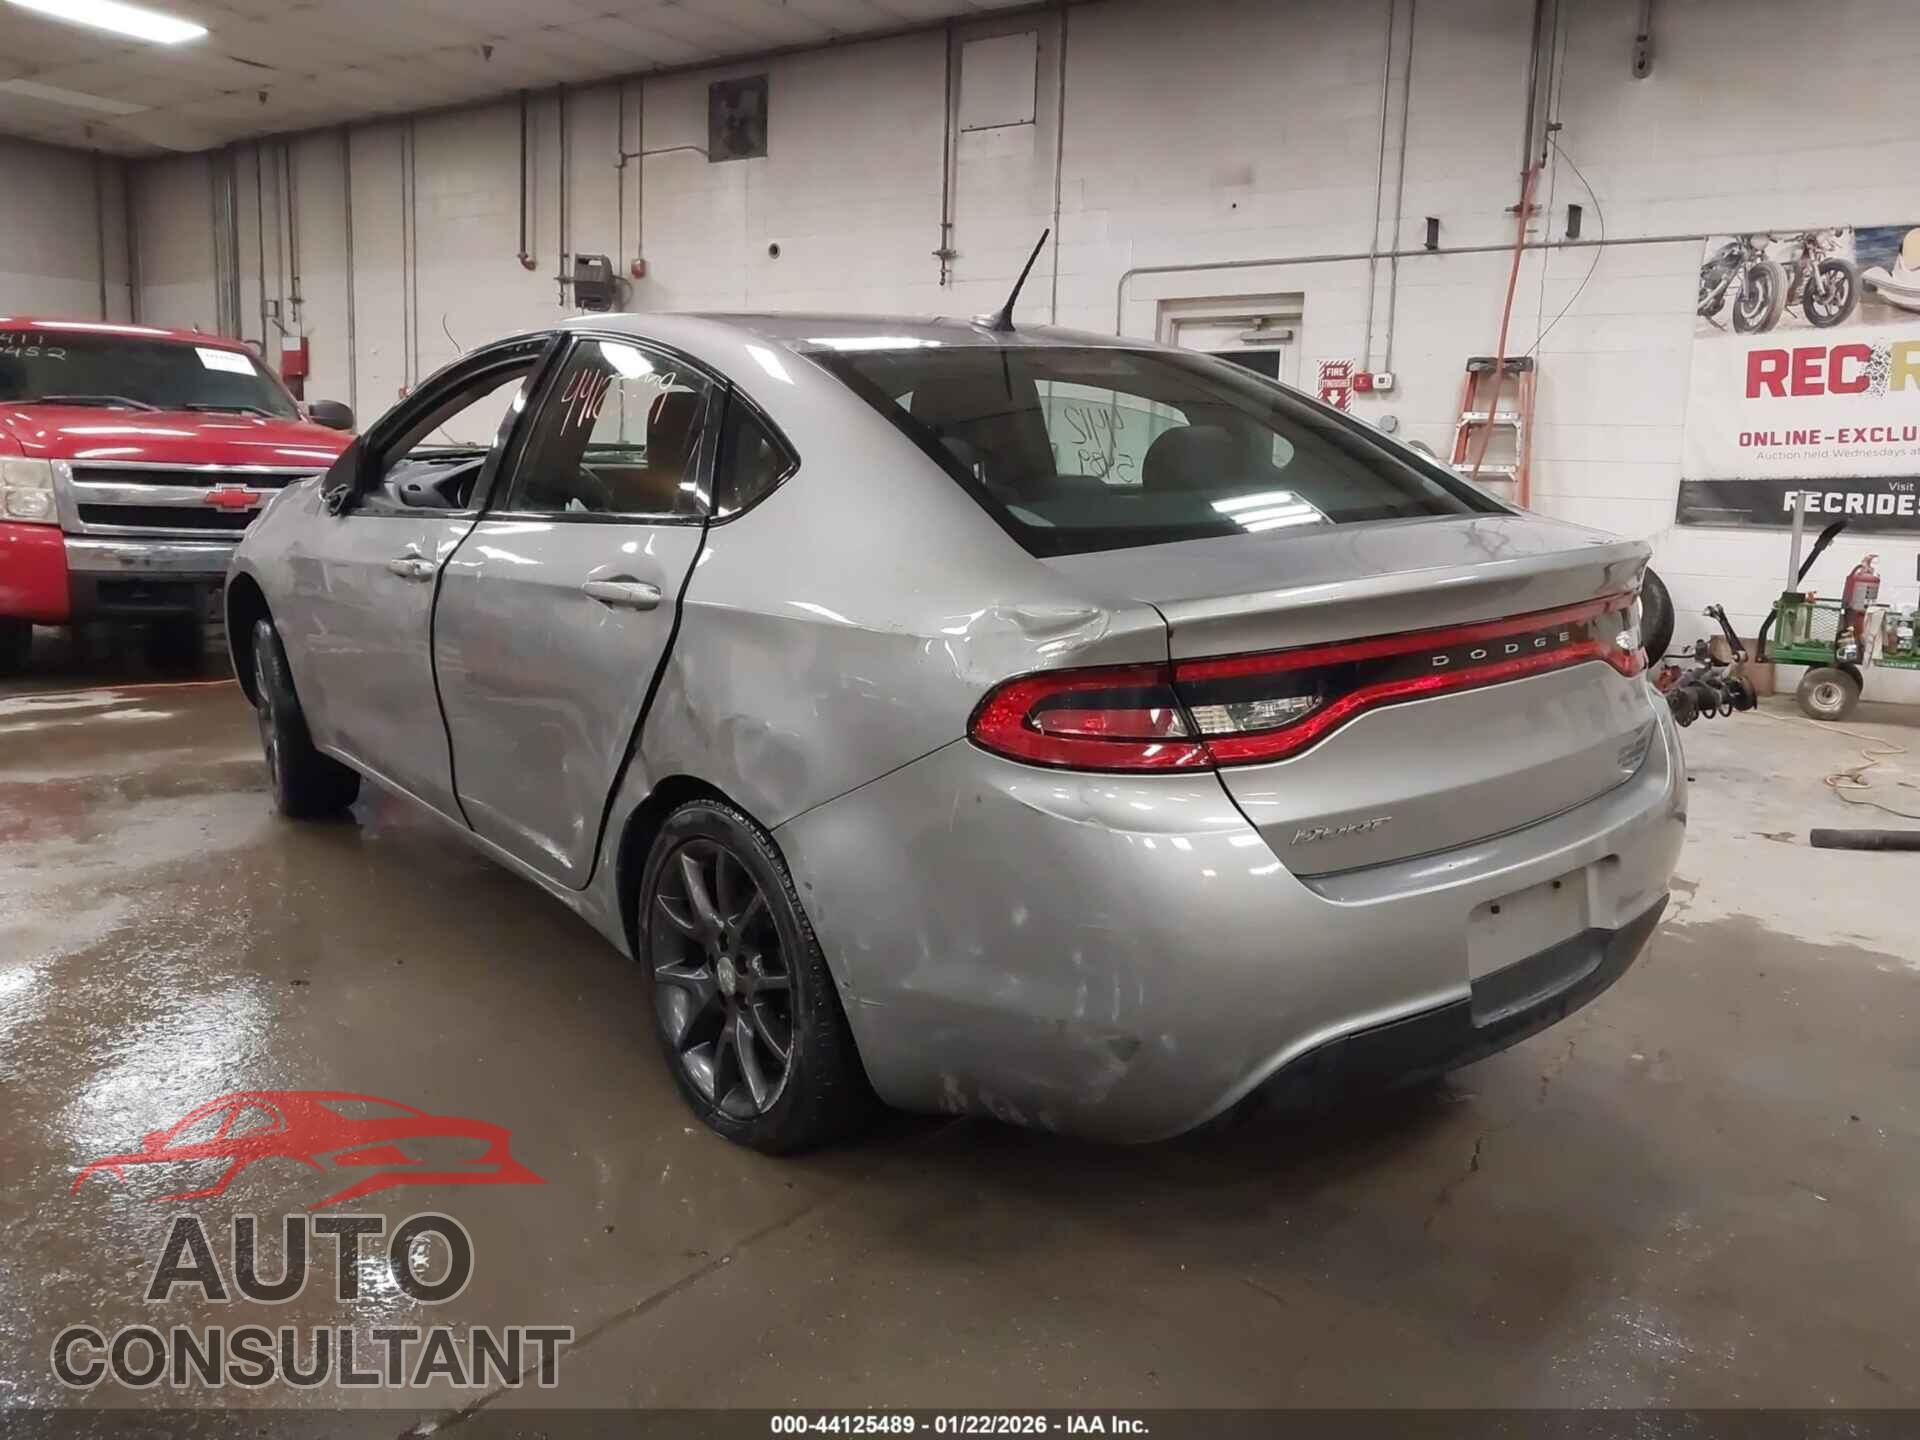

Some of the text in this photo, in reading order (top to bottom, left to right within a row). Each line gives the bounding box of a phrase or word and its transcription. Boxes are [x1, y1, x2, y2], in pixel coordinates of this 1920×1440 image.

[1326, 367, 1345, 377] FIRE
[1746, 344, 1872, 399] REC
[1756, 449, 1802, 460] Auction
[1803, 447, 1829, 459] held
[1832, 446, 1907, 461] Wednesdays
[1888, 481, 1915, 492] Visit
[1783, 492, 1920, 516] RECRIDE
[1431, 632, 1571, 667] DODGE
